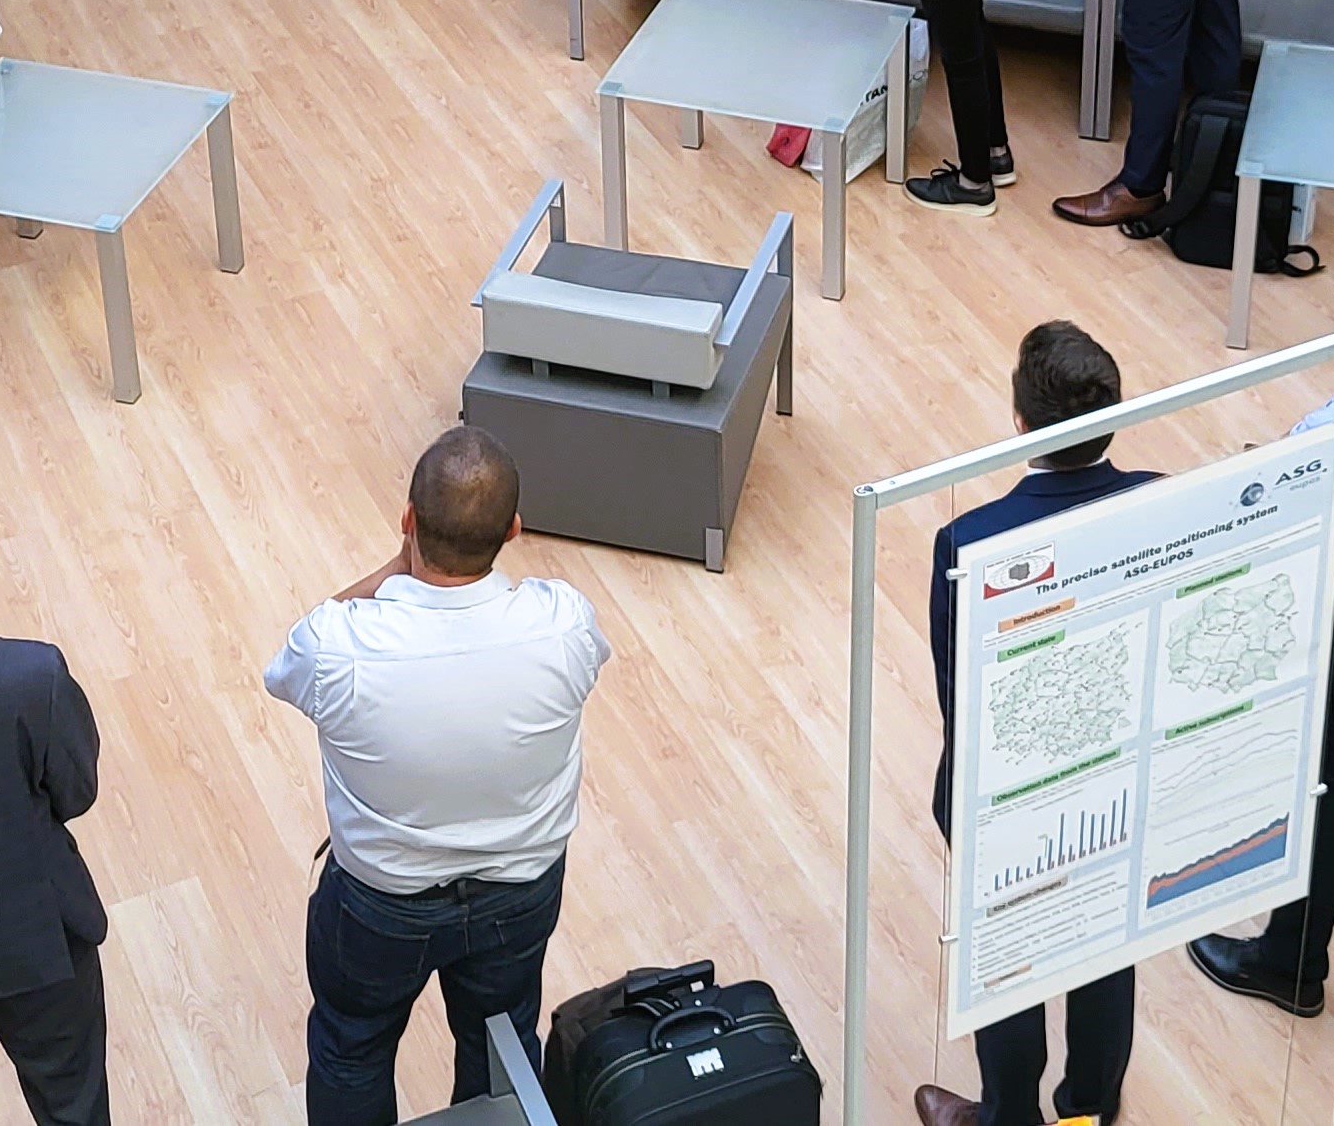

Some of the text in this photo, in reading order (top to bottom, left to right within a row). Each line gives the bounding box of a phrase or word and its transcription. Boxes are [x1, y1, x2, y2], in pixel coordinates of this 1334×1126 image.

[1275, 459, 1322, 486] ASG
[1036, 505, 1278, 595] The precise satellite positioning system
[1124, 547, 1194, 580] ASG-EUPOS
[1014, 605, 1061, 624] Introduction
[1007, 642, 1036, 656] Current
